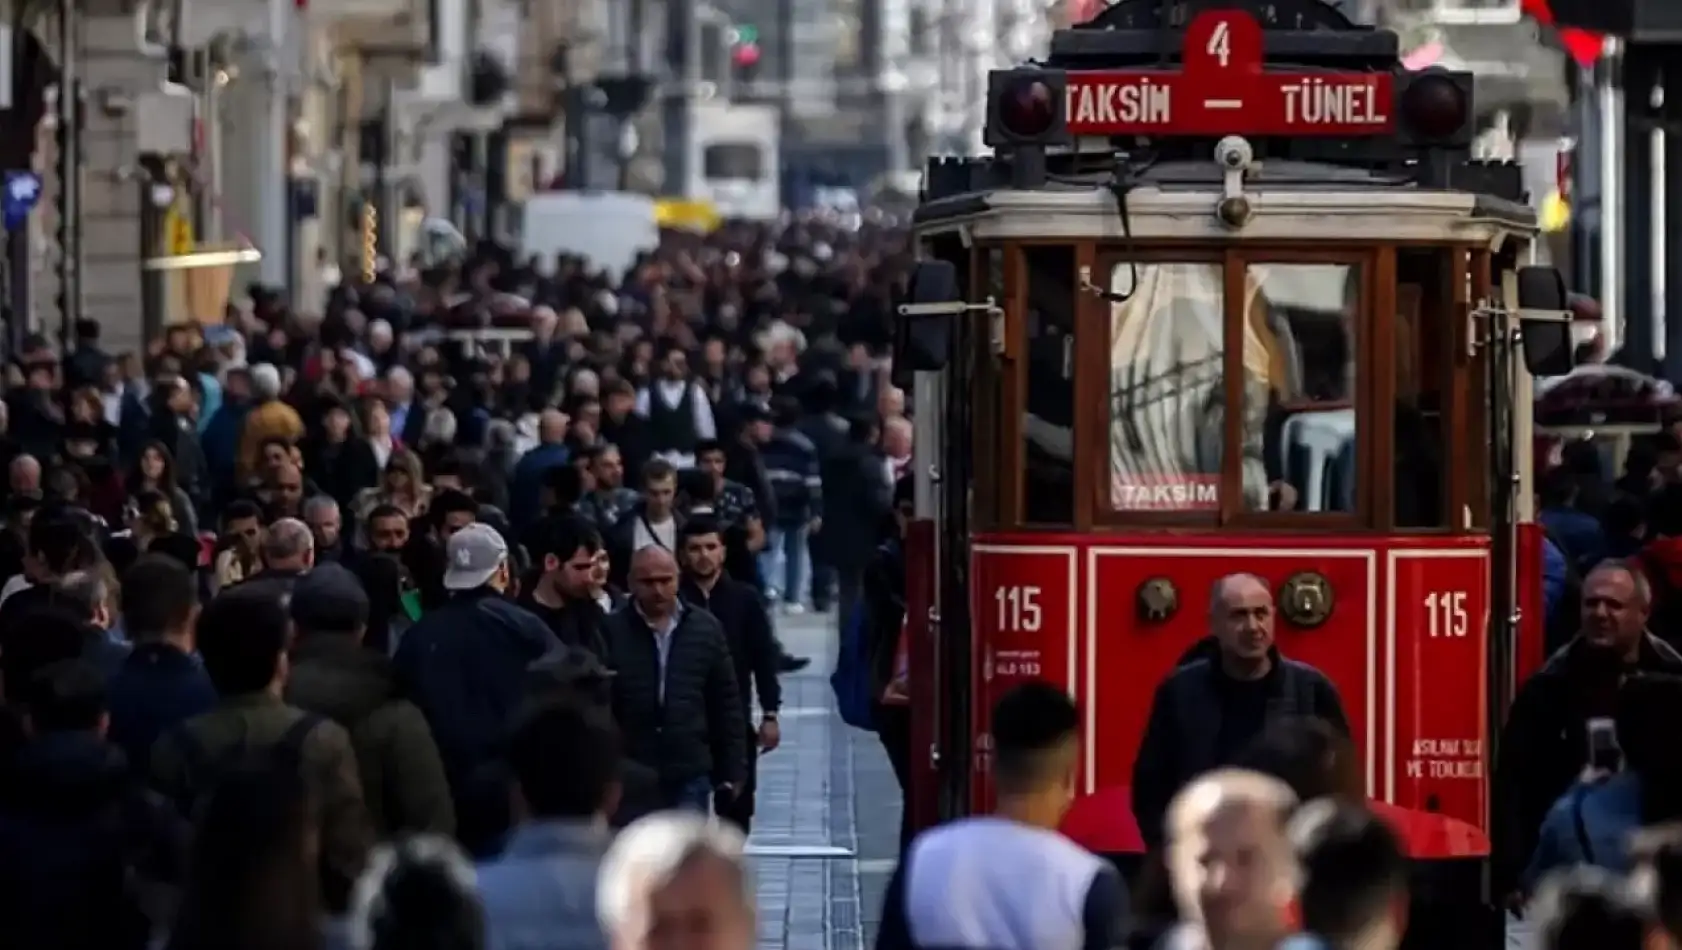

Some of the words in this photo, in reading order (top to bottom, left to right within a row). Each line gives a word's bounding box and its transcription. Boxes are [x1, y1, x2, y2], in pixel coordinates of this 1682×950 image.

[1206, 20, 1230, 67] 4
[1280, 78, 1387, 123] TÜNEL
[995, 586, 1041, 632] 115
[1424, 591, 1467, 637] 115
